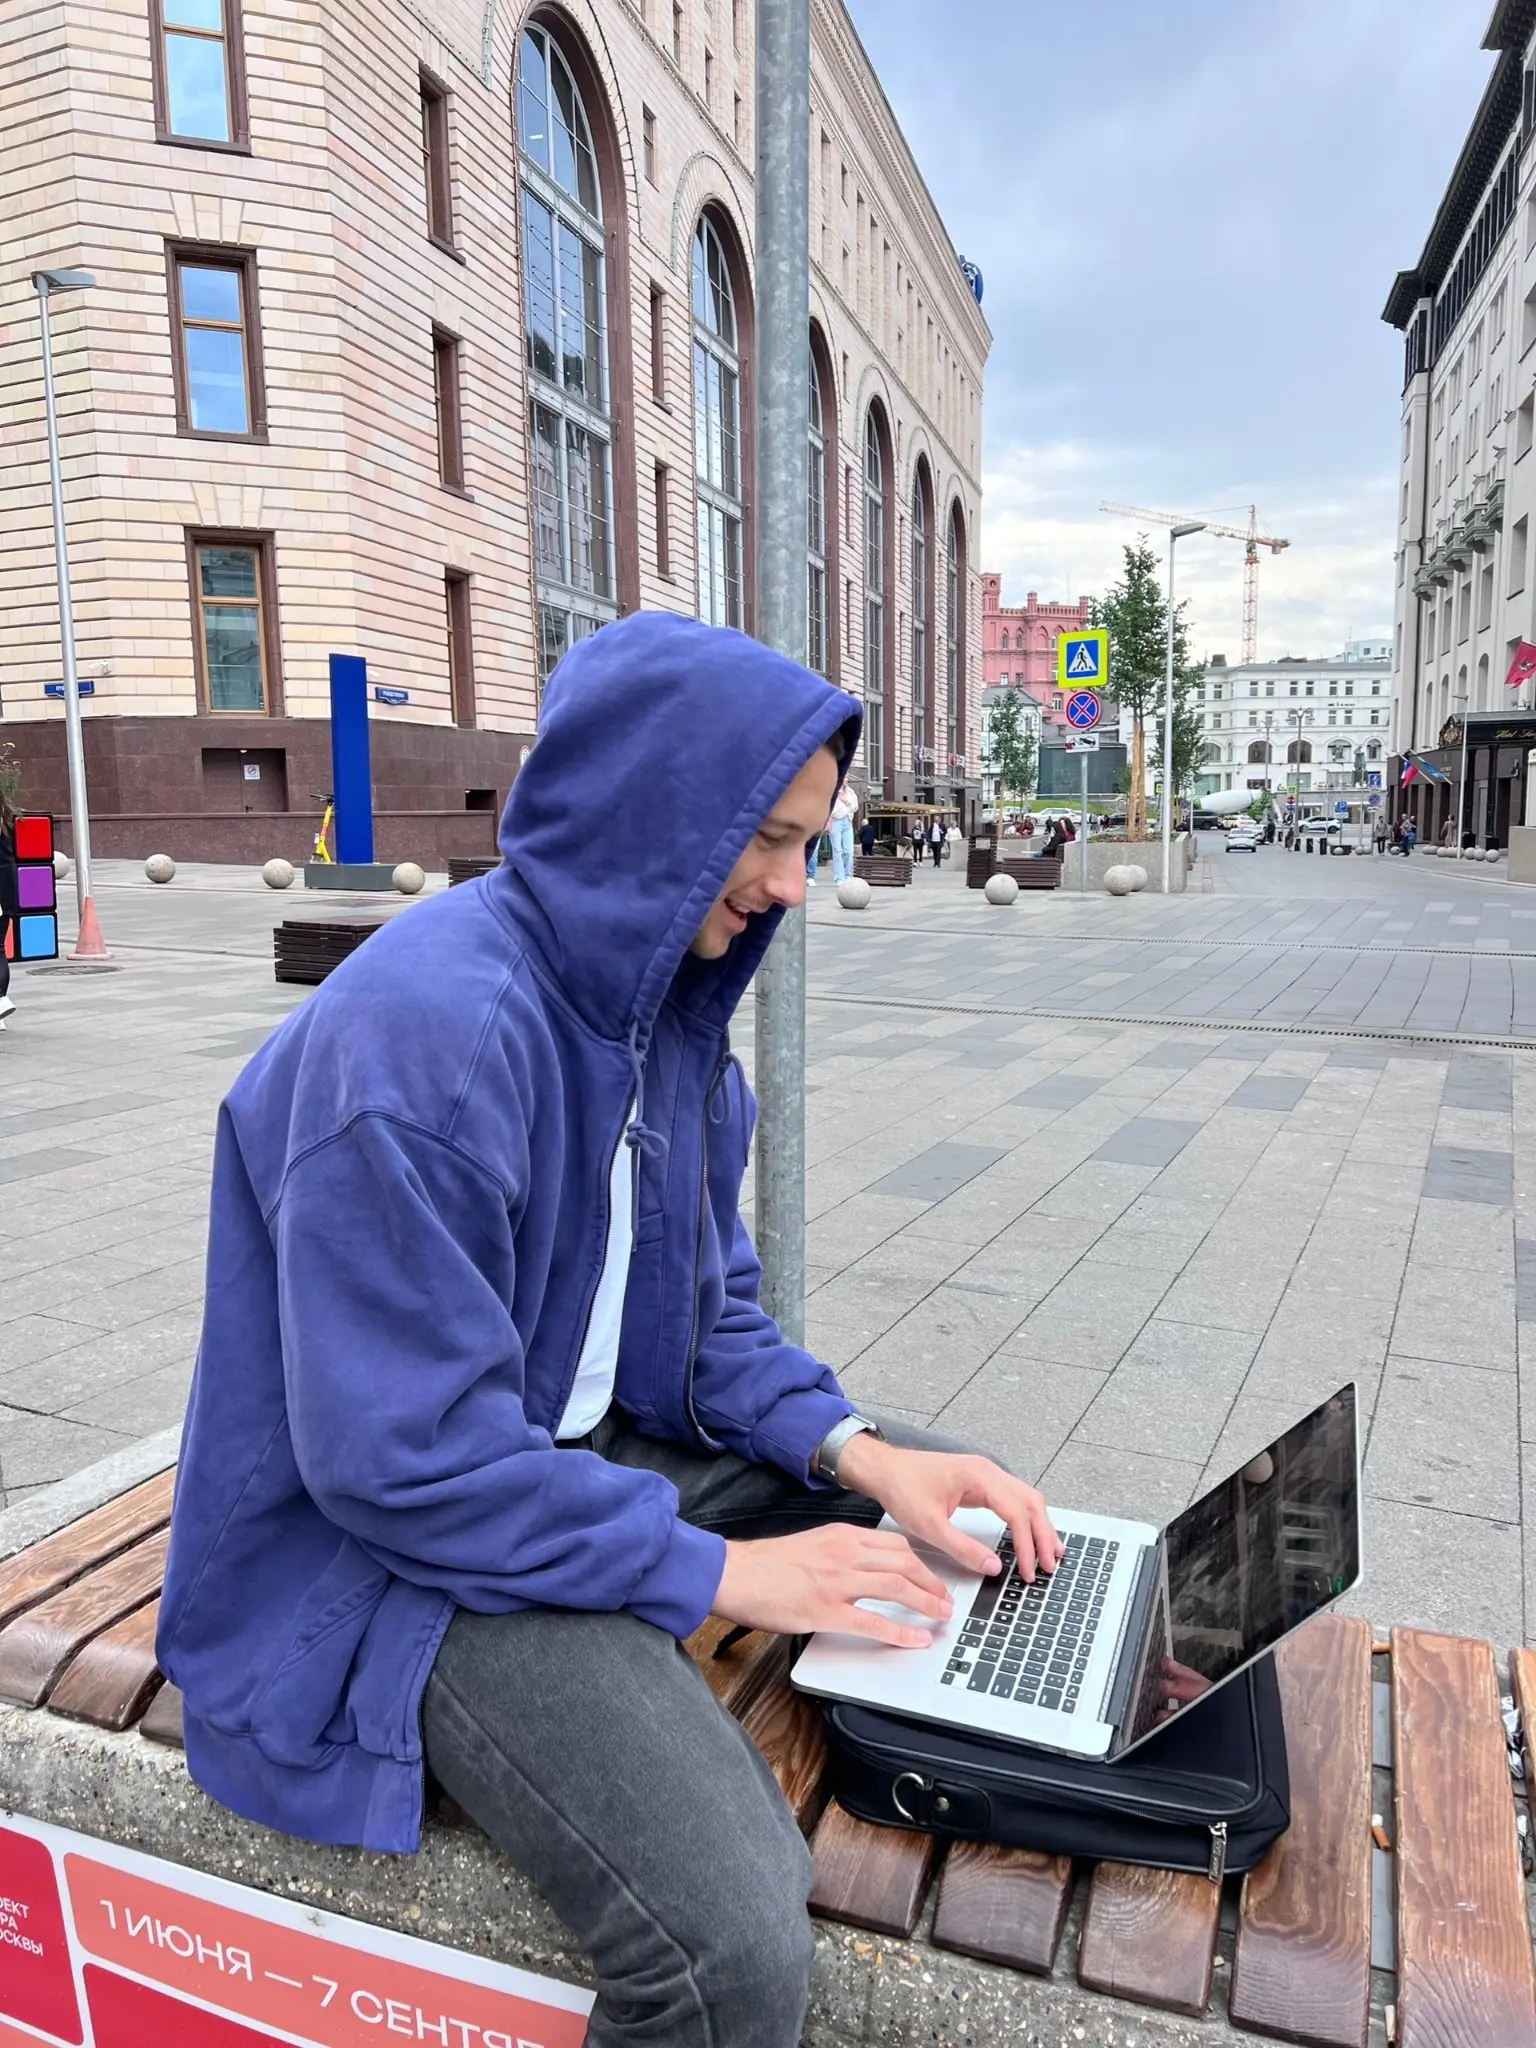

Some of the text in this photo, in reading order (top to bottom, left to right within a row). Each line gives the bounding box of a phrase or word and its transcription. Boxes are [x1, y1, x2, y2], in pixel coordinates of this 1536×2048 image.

[100, 1900, 117, 1930] 1
[125, 1907, 253, 1982] ИЮНЯ
[312, 1974, 339, 2008] 7
